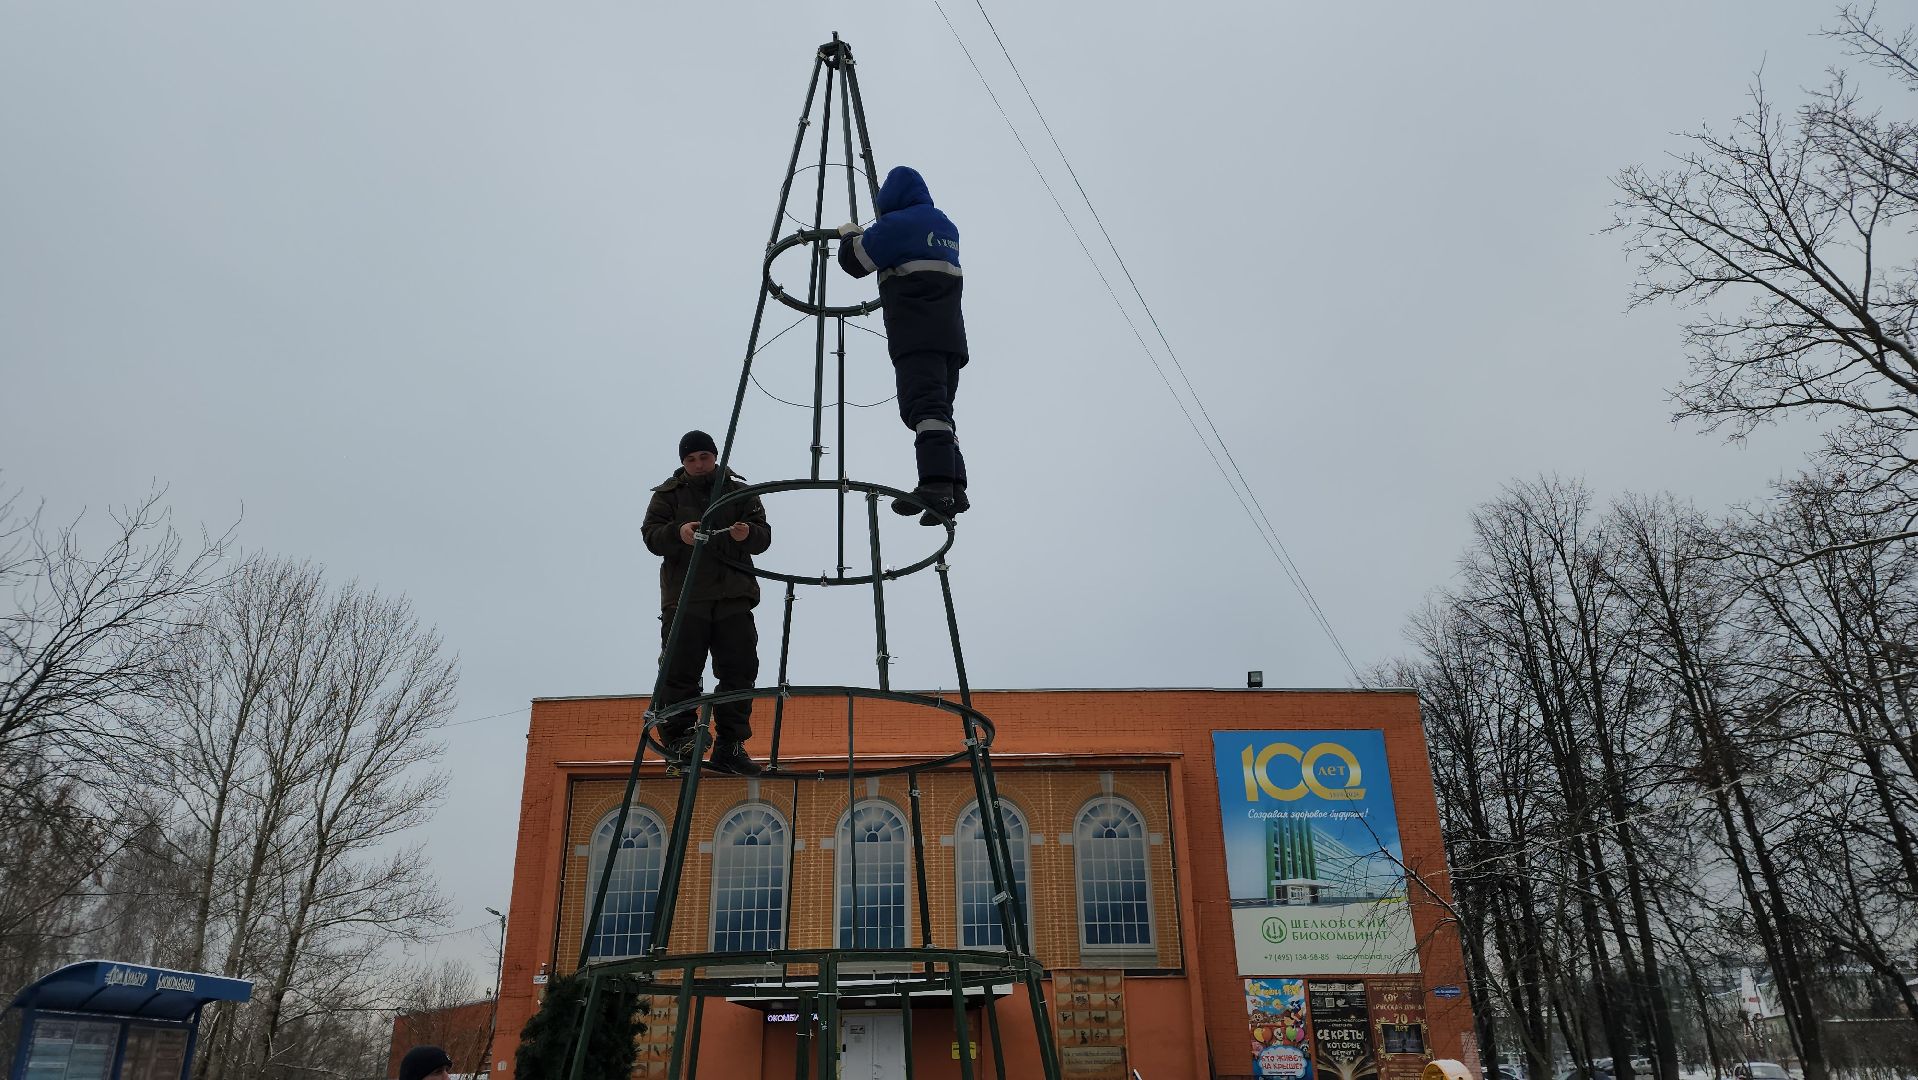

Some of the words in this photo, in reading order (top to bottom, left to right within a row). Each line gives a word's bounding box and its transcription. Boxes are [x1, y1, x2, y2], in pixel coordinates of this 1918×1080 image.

[1247, 808, 1289, 821] Создавая
[1290, 809, 1327, 821] здоровое
[1292, 930, 1388, 941] БИОКОМБИНАТ
[1394, 1013, 1408, 1025] 70
[1326, 1042, 1361, 1050] КОТОРЫЕ
